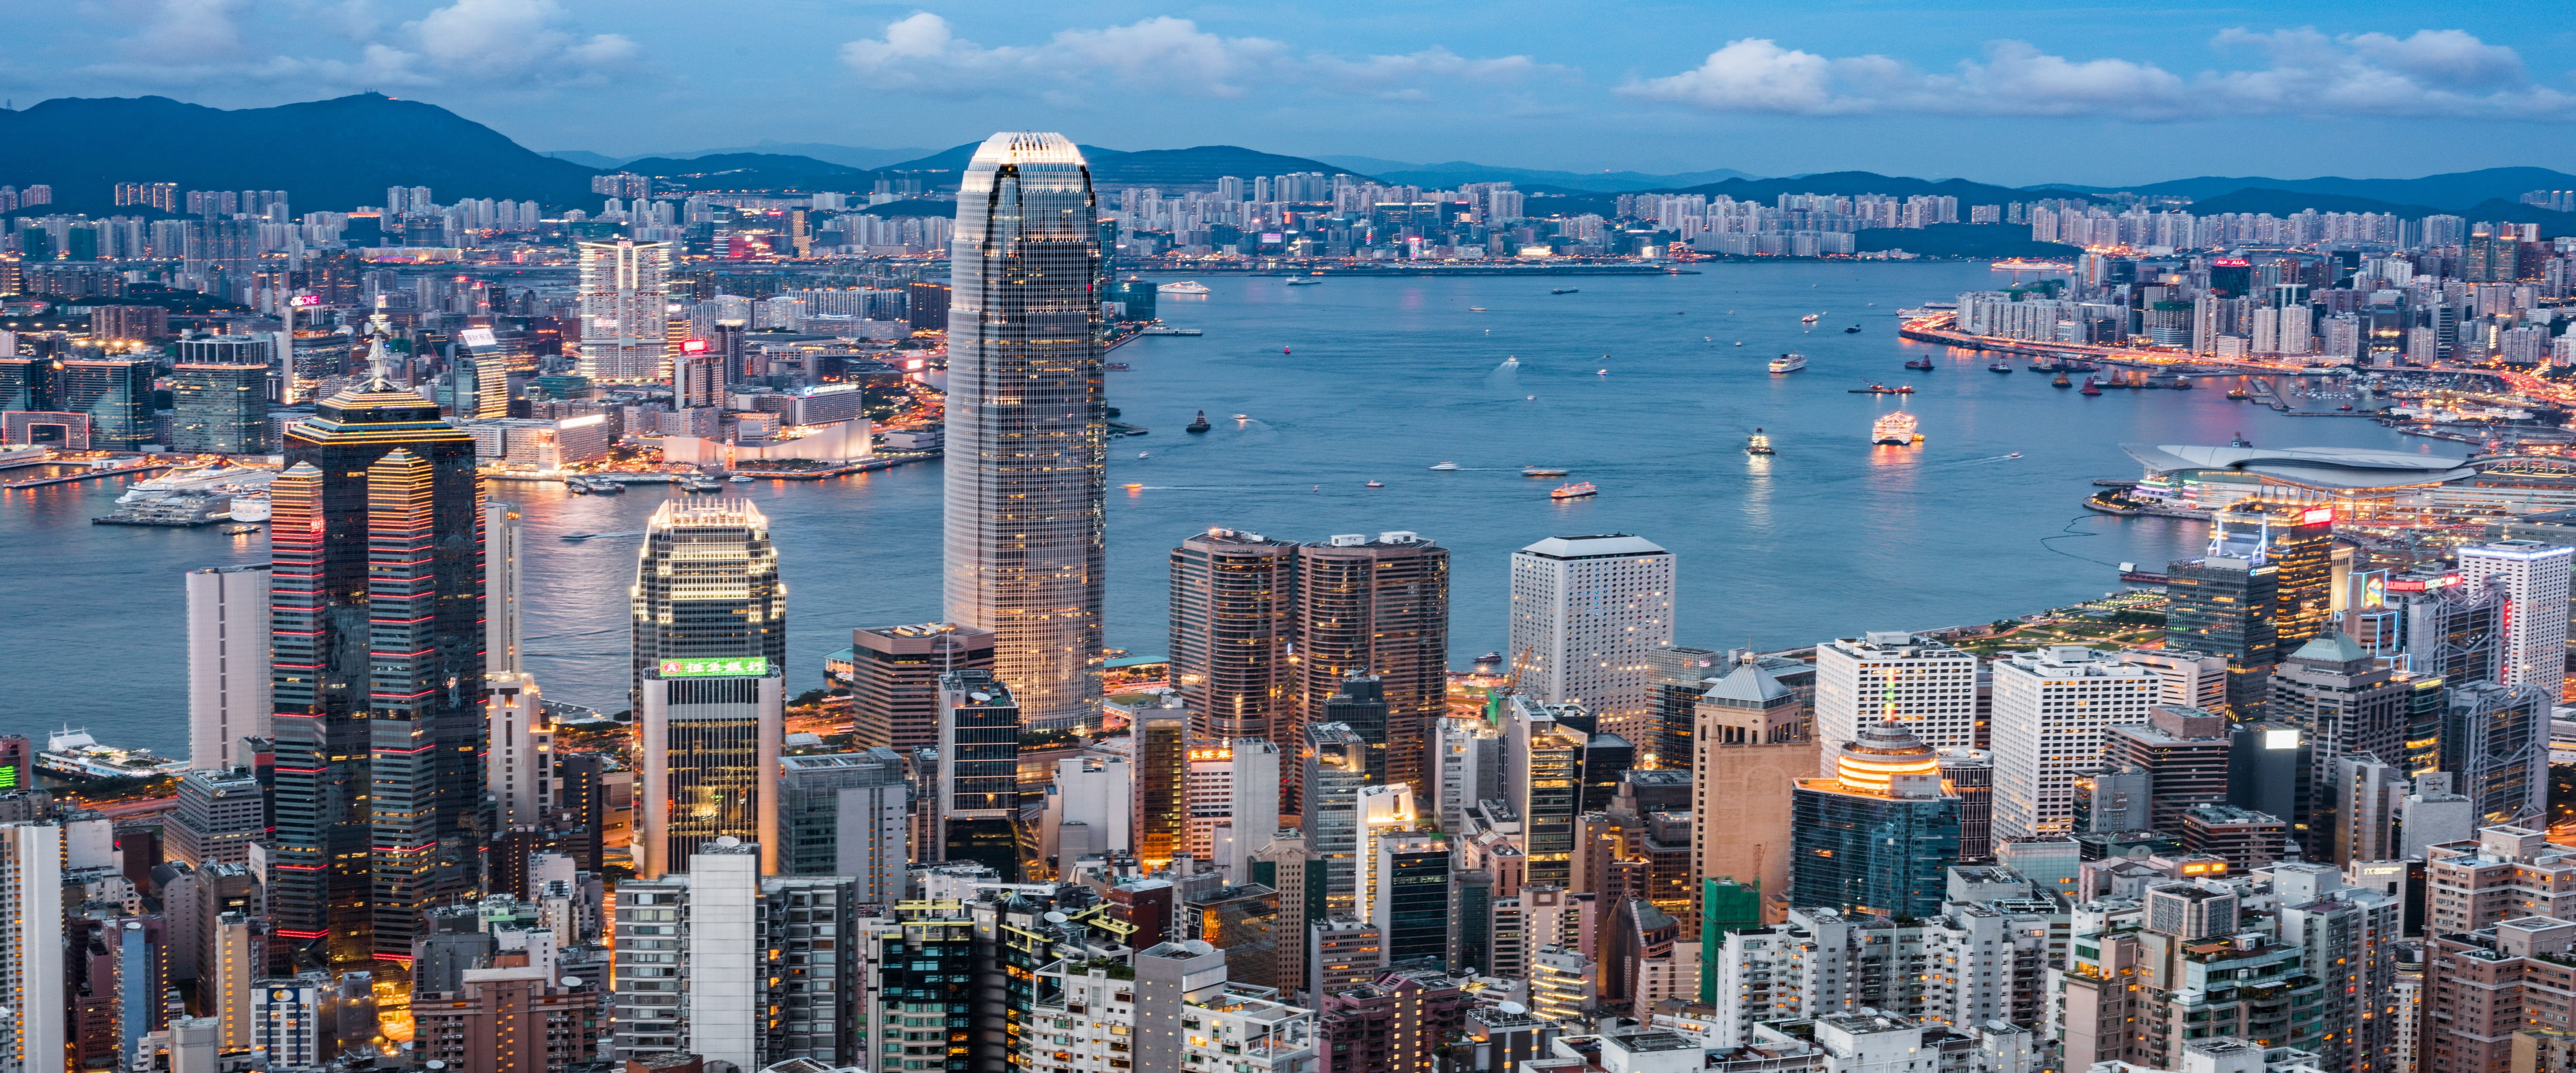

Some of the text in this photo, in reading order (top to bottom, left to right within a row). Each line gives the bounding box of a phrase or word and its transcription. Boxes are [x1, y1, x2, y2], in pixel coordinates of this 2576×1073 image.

[302, 296, 317, 305] ONE
[2425, 577, 2446, 590] HSBC
[685, 661, 764, 673] 恒生銀行
